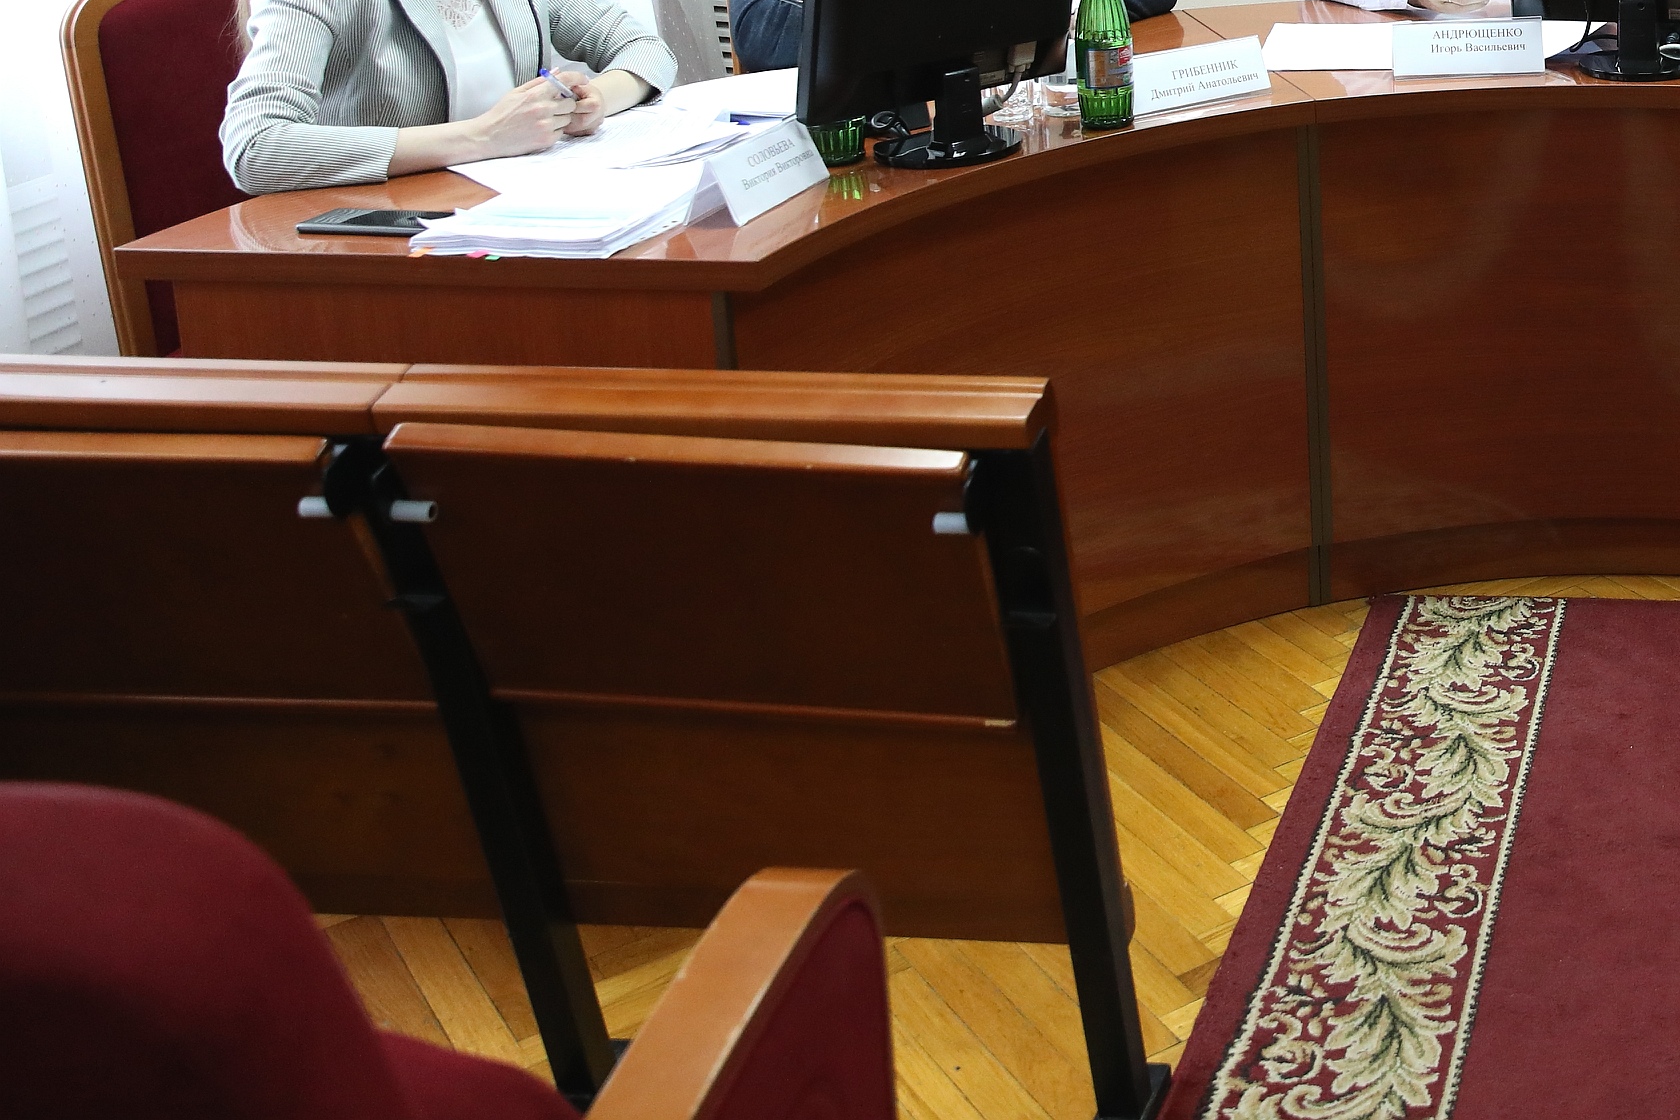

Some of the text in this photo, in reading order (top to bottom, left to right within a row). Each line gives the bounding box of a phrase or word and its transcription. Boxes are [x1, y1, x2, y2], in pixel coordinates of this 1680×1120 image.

[1432, 27, 1523, 40] АНДРЮЩЕНКО
[1430, 42, 1526, 55] Игорь Васильевич
[1171, 59, 1239, 80] ГРИБЕННИК
[1150, 71, 1259, 101] Дмитрий Анатольевич
[747, 138, 796, 168] СОЛОВЬЕВА
[741, 149, 815, 191] Виктория Викторовна
